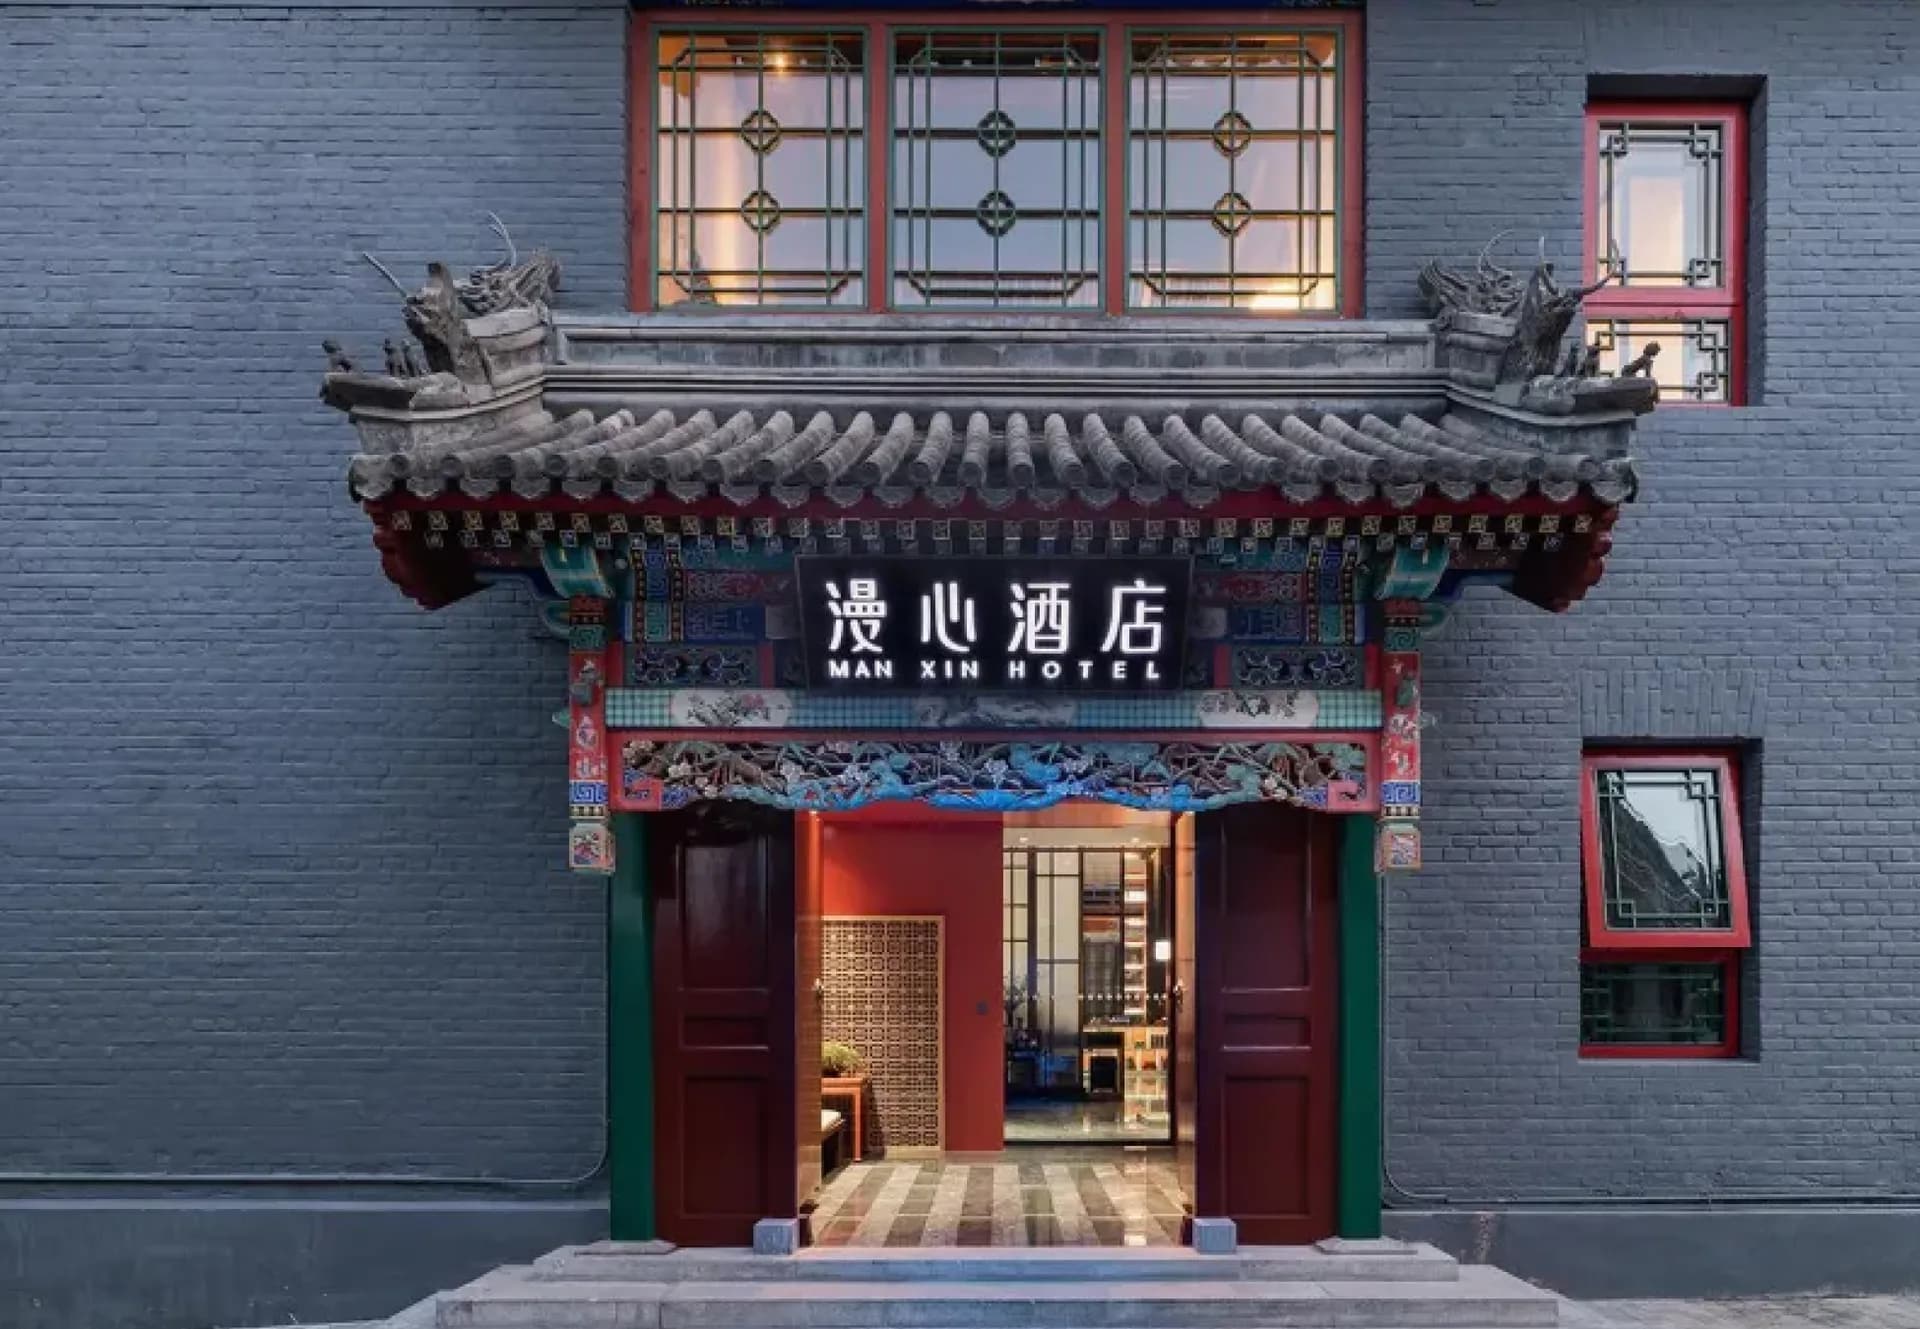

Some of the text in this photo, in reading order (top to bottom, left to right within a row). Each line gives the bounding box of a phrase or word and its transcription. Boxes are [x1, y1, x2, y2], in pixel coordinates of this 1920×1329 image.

[825, 578, 1167, 654] 漫心酒店
[828, 660, 1160, 679] MAN XIN HOTEL
